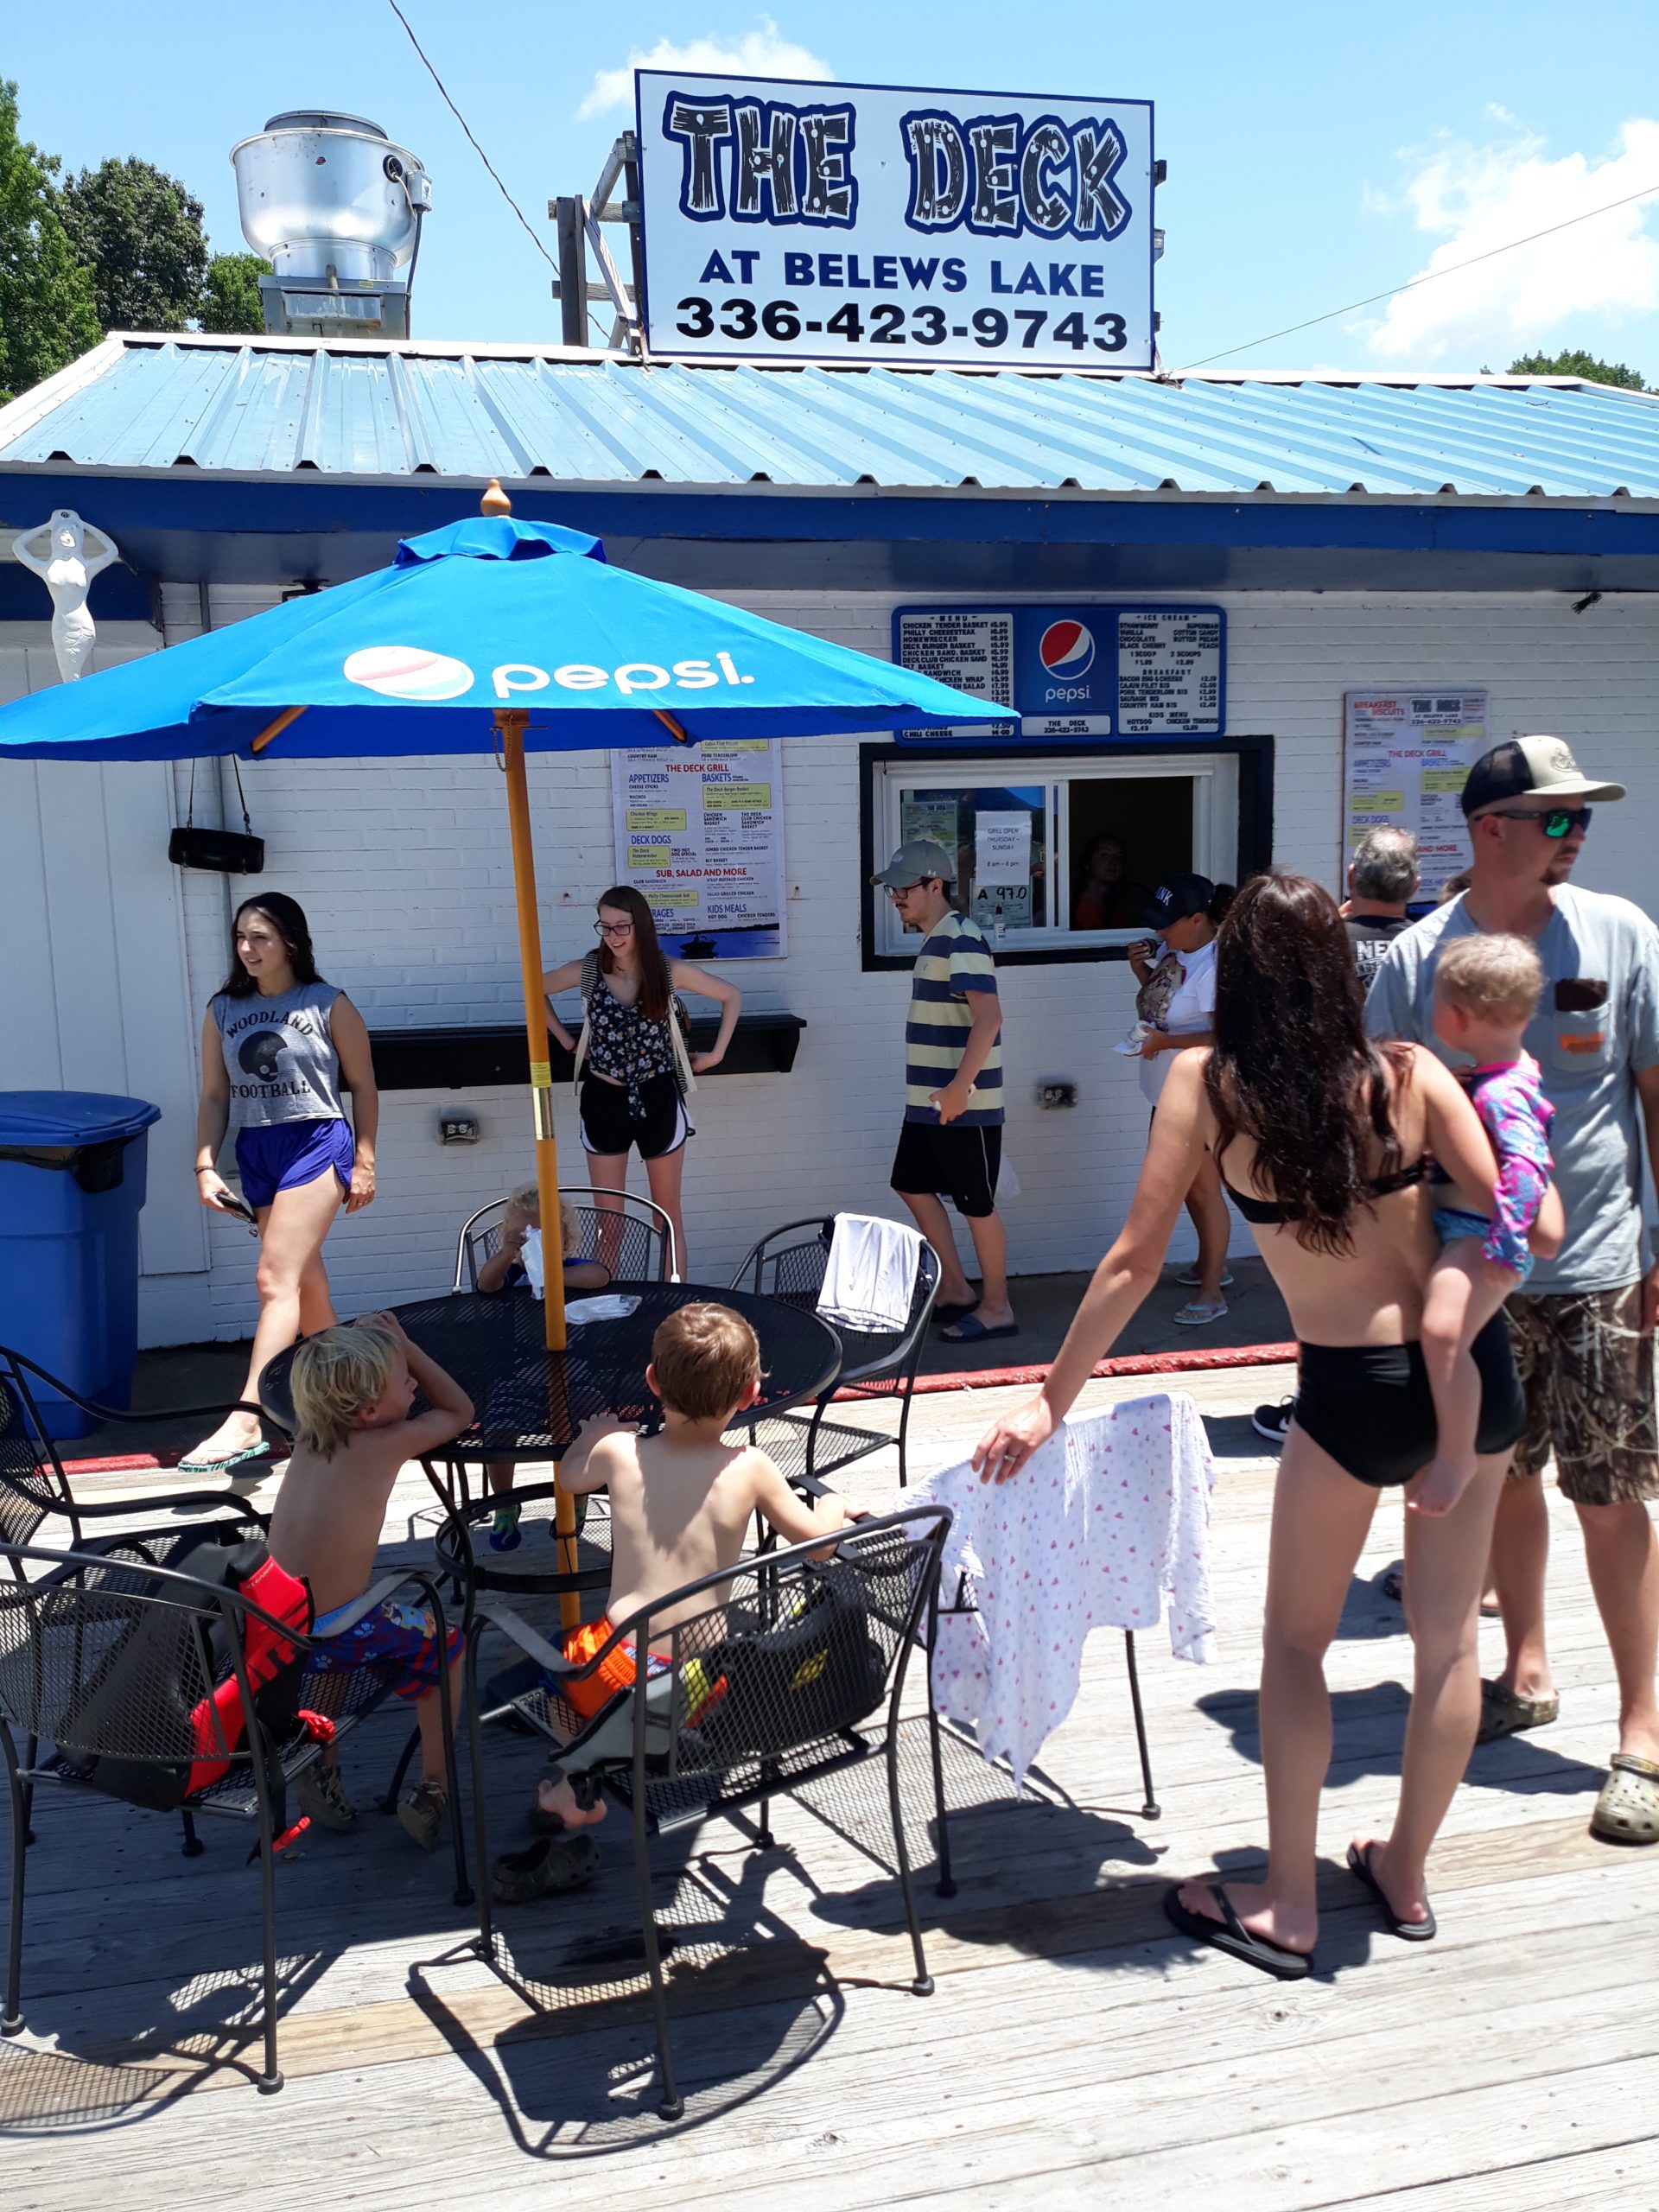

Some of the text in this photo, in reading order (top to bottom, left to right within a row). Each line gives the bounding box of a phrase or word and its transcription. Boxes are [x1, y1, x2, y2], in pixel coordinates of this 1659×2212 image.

[663, 91, 1132, 241] THE DECK
[698, 250, 1104, 297] AT BELEWS LAKE
[675, 296, 1127, 353] 336-423-9743
[629, 774, 669, 783] APPETIZERS
[702, 773, 731, 782] BASKETS
[632, 836, 671, 844] DECK DOGS
[977, 887, 1027, 899] A 97.0
[708, 904, 747, 913] KIDS MEALS
[226, 1011, 313, 1038] WOODLAND
[231, 1081, 311, 1098] FOOTBALL
